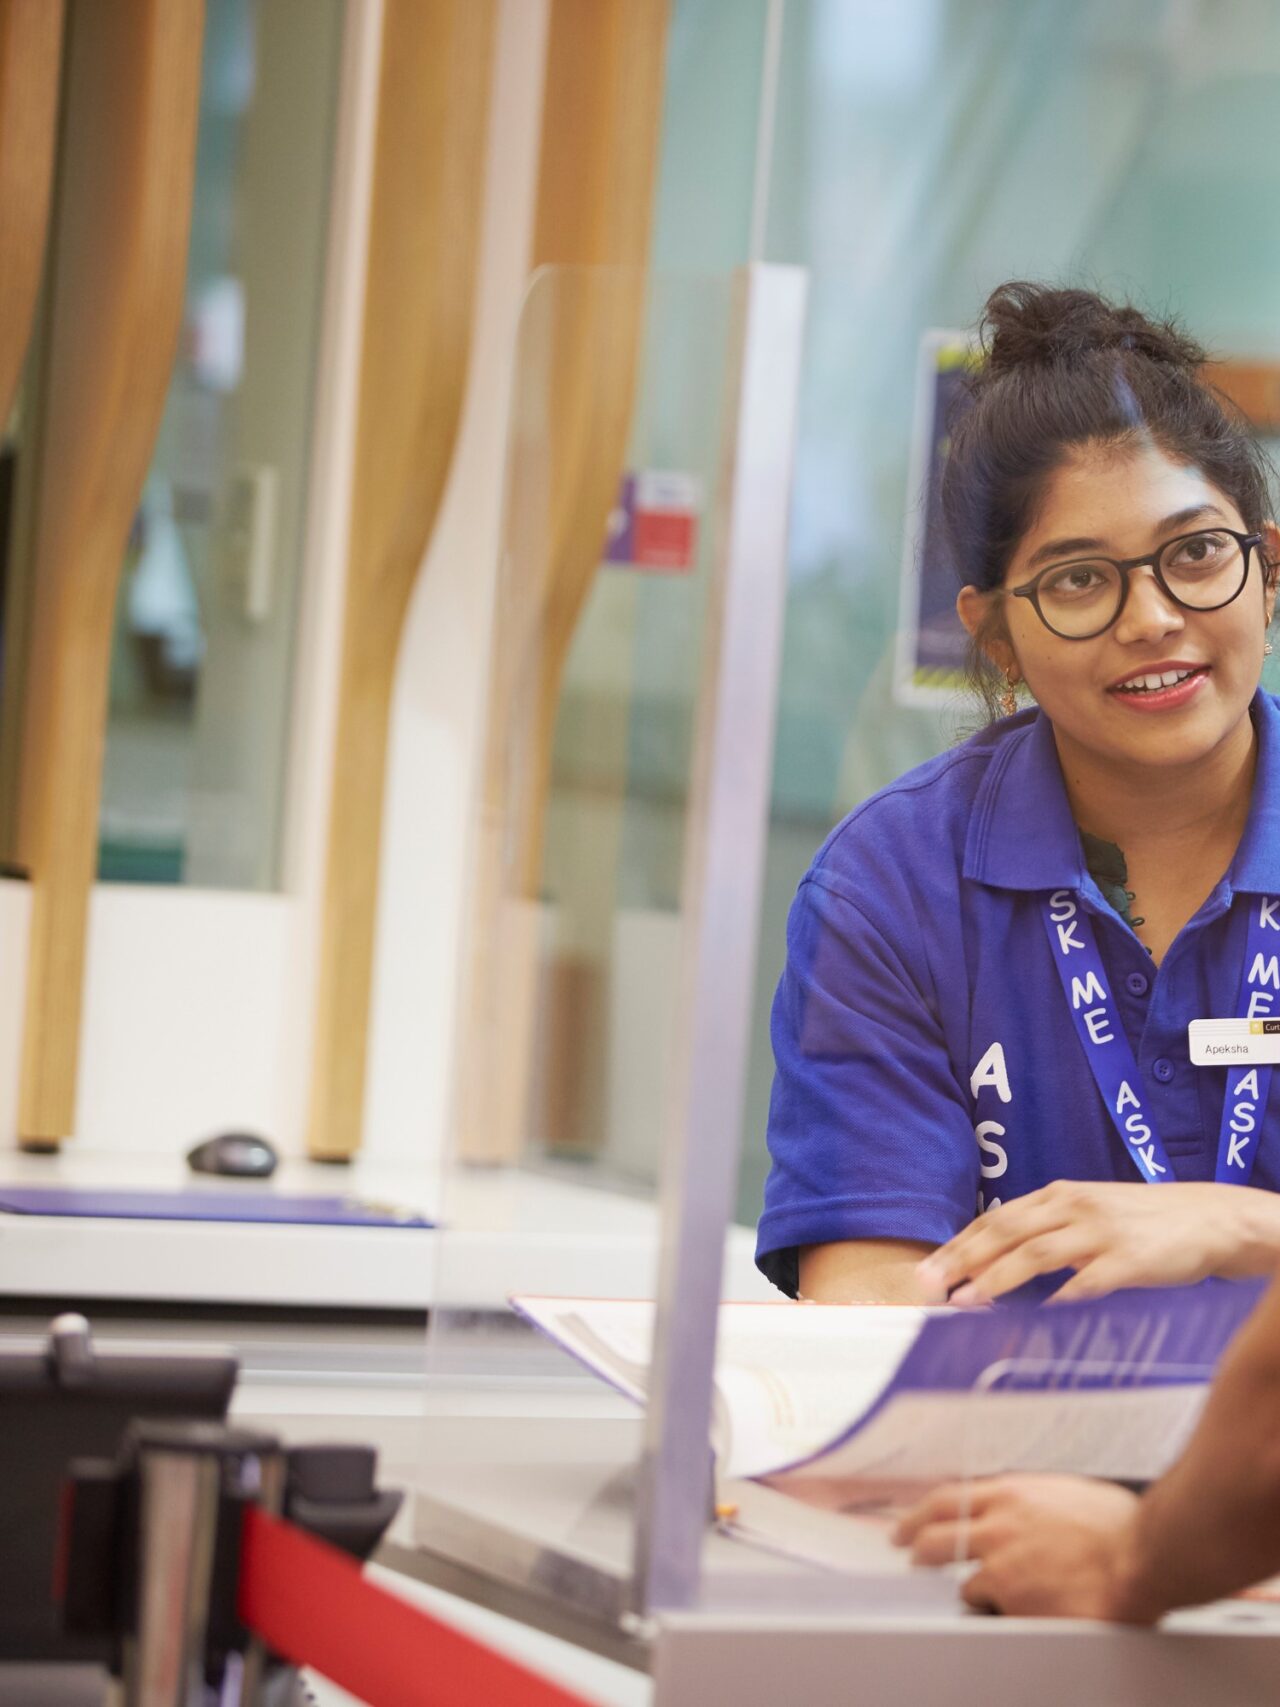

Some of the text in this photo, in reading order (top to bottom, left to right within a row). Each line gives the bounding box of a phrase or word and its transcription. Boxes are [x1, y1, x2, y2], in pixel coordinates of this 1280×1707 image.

[1050, 890, 1166, 1176] SK ME ASK
[1205, 1044, 1249, 1054] Apeksha
[1226, 1069, 1260, 1169] ASK
